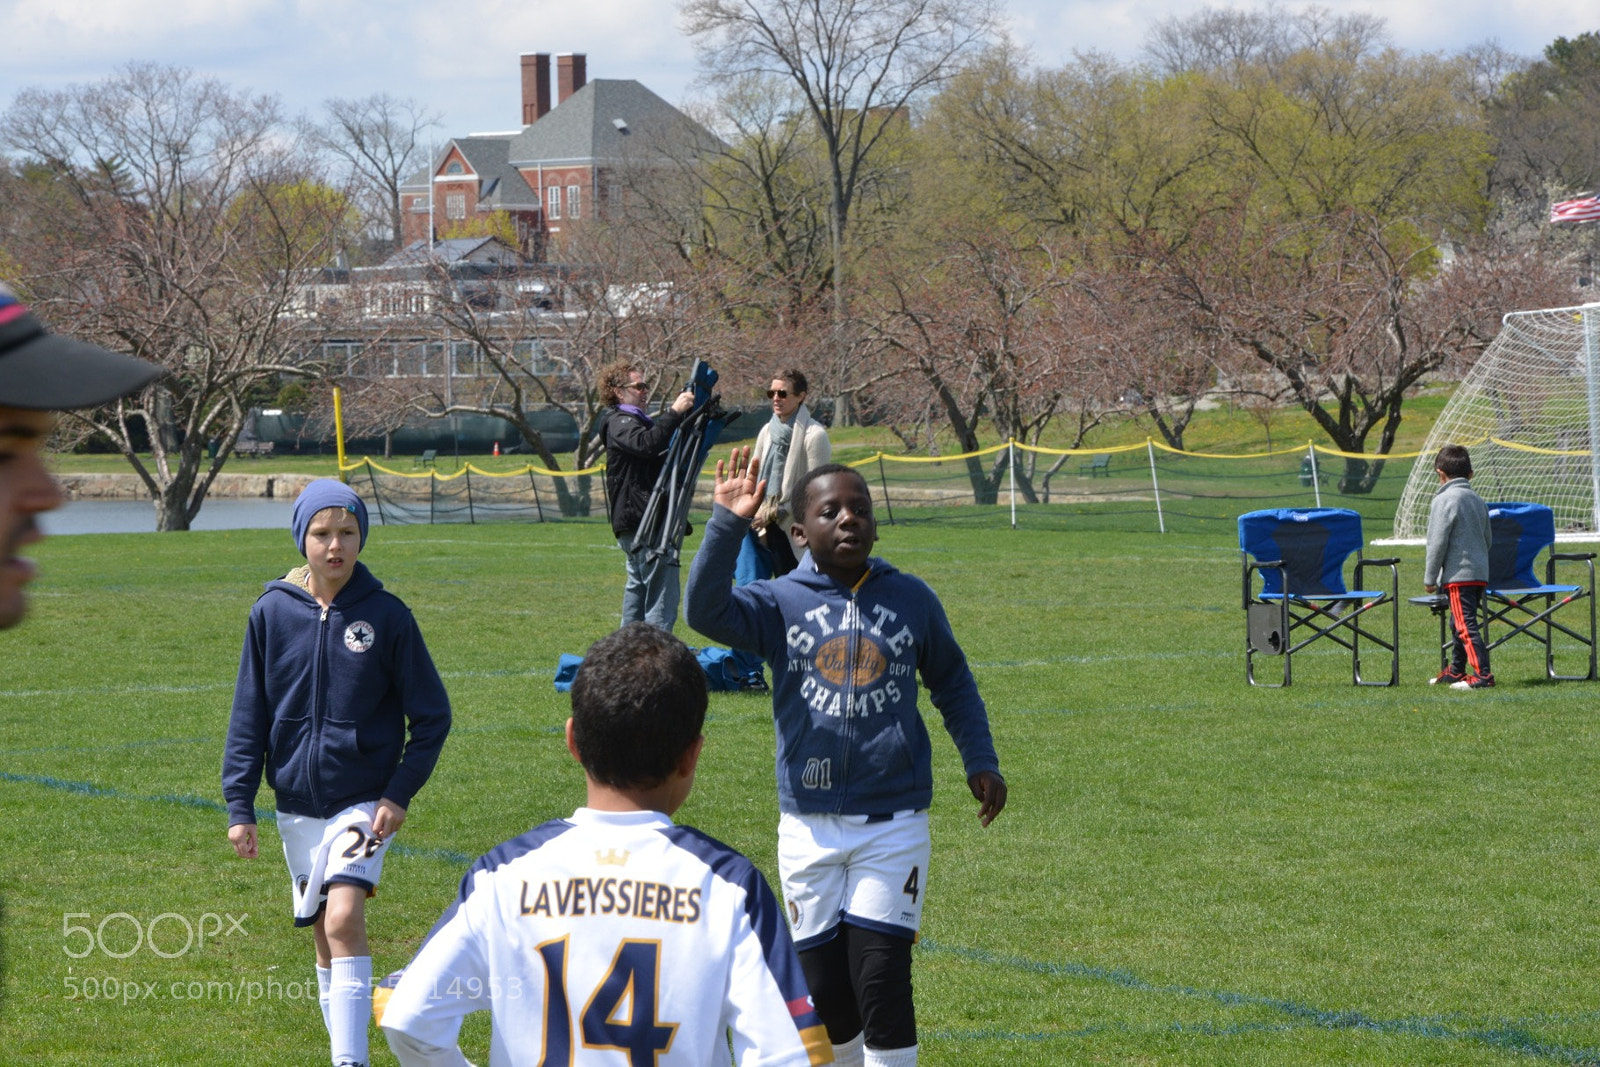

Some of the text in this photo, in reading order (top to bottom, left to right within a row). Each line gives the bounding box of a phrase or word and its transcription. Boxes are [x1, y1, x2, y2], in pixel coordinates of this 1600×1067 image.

[786, 600, 914, 657] STATE
[787, 658, 911, 677] ATHL DEPT
[800, 675, 901, 718] CHAMPS
[801, 757, 831, 789] 01
[520, 877, 702, 924] LAVEYSSIERES
[903, 864, 919, 904] 4
[534, 932, 681, 1067] 14
